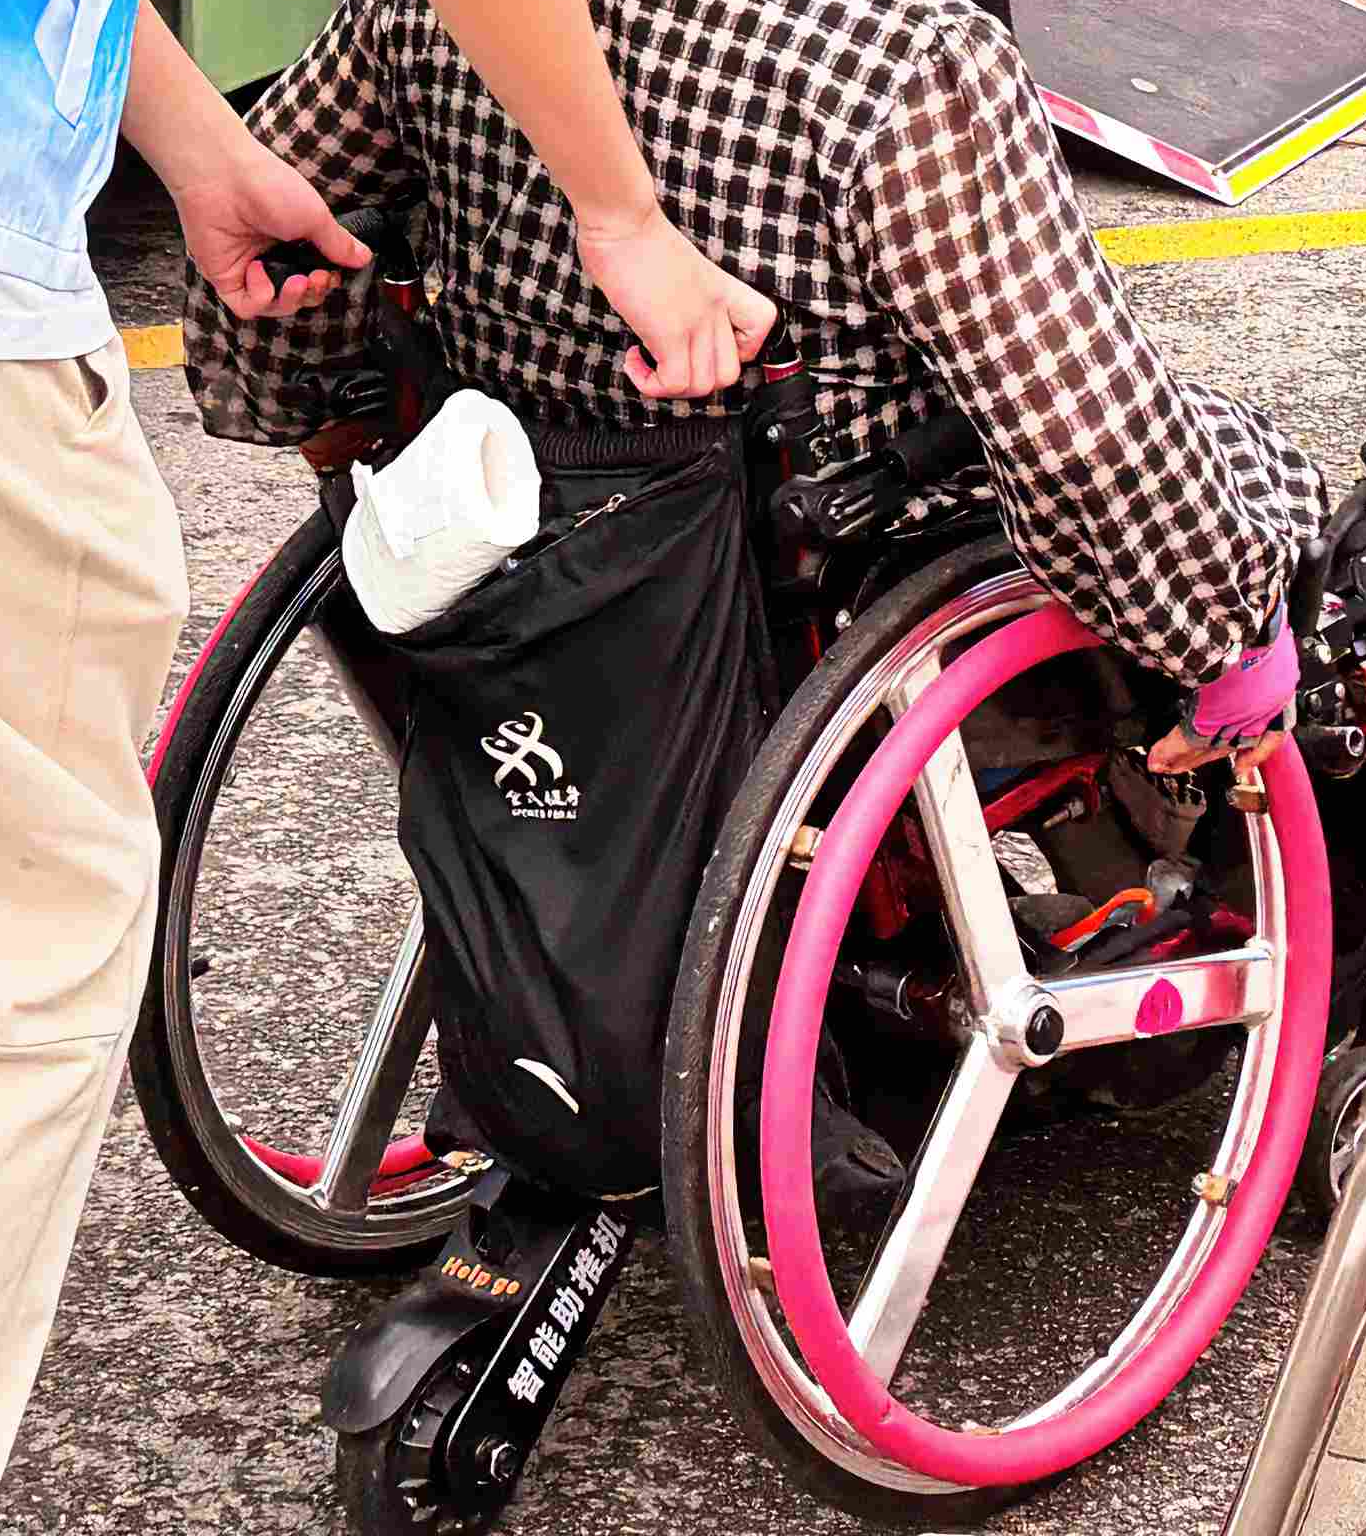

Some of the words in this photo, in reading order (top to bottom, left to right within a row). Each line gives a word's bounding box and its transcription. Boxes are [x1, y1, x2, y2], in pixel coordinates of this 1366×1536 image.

[442, 1256, 492, 1289] Help
[490, 1277, 521, 1296] go
[507, 1211, 627, 1404] 智能助推机
